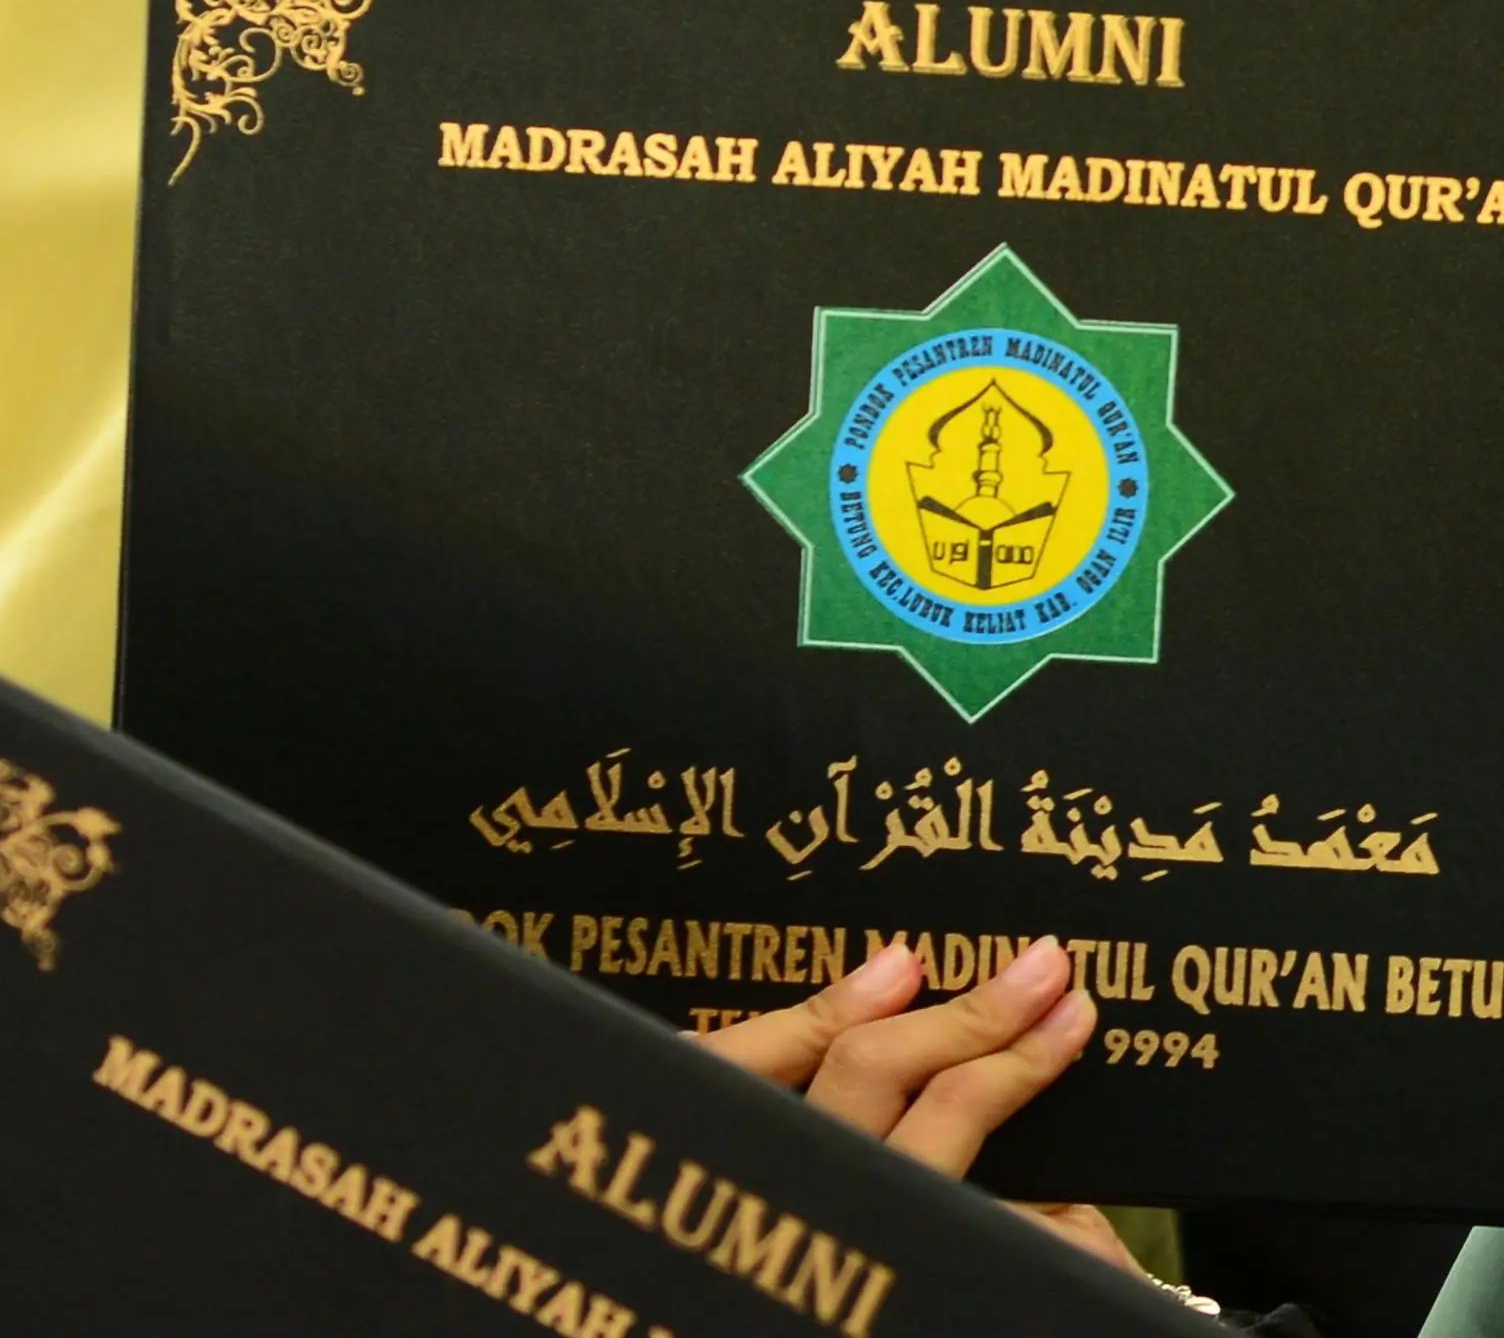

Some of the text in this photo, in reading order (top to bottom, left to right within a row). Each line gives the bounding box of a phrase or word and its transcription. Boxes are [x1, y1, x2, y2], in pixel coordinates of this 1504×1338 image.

[837, 0, 1185, 88] ALUMNI
[439, 120, 760, 184] MADRASAH
[771, 140, 984, 197] ALIYAH
[998, 151, 1329, 216] MADINATUL
[844, 382, 895, 450] PONDOK
[892, 335, 993, 387] PESANTREN
[1005, 337, 1101, 400] MADINATUL
[570, 914, 848, 987] PESANTREN
[864, 929, 1155, 1002] ADINTUL
[1171, 944, 1370, 1016] QUR'AN
[1104, 1027, 1220, 1070] 9994
[94, 1036, 418, 1242] MADRASAH
